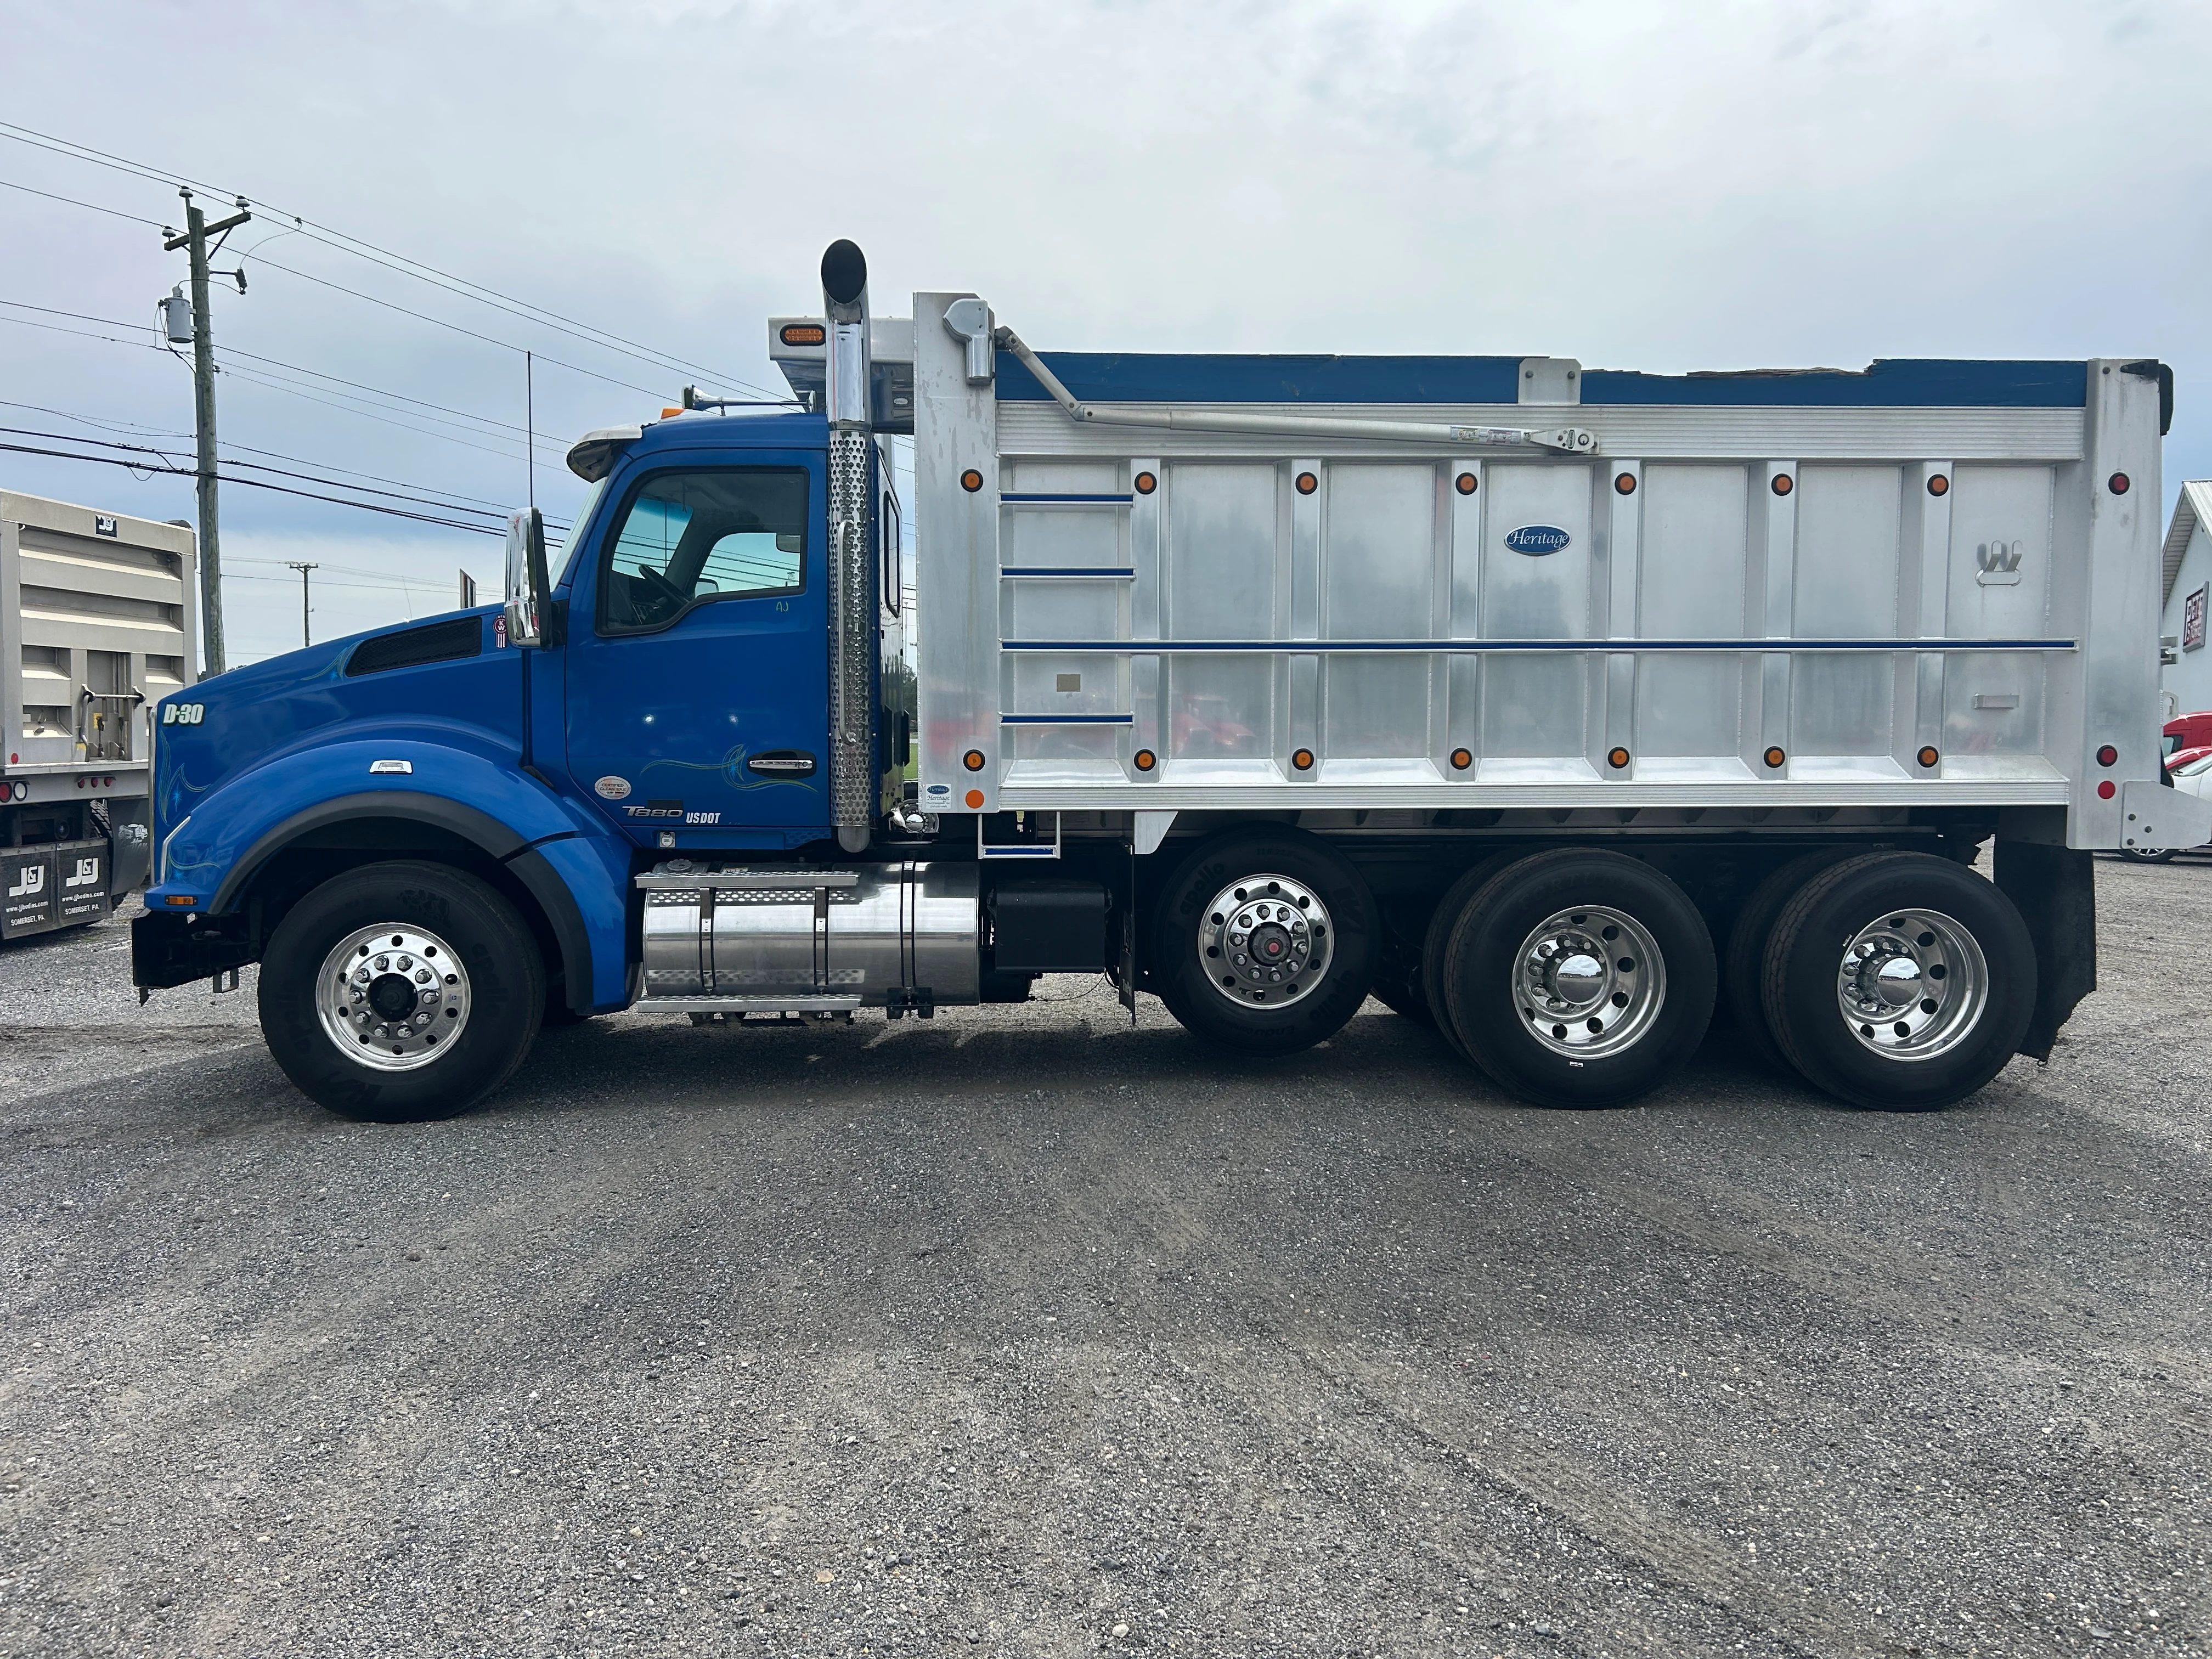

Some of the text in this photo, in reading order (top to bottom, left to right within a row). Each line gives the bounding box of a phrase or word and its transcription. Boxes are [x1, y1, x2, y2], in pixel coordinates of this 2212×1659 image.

[1509, 528, 1568, 548] Heritage
[163, 704, 204, 724] D-30
[622, 806, 683, 817] T880
[9, 865, 44, 896] J&J
[66, 858, 98, 887] J&J
[62, 891, 104, 902] www.jjbodies.com
[1180, 863, 1225, 915] apollo
[5, 901, 48, 912] www.jjbodies.com
